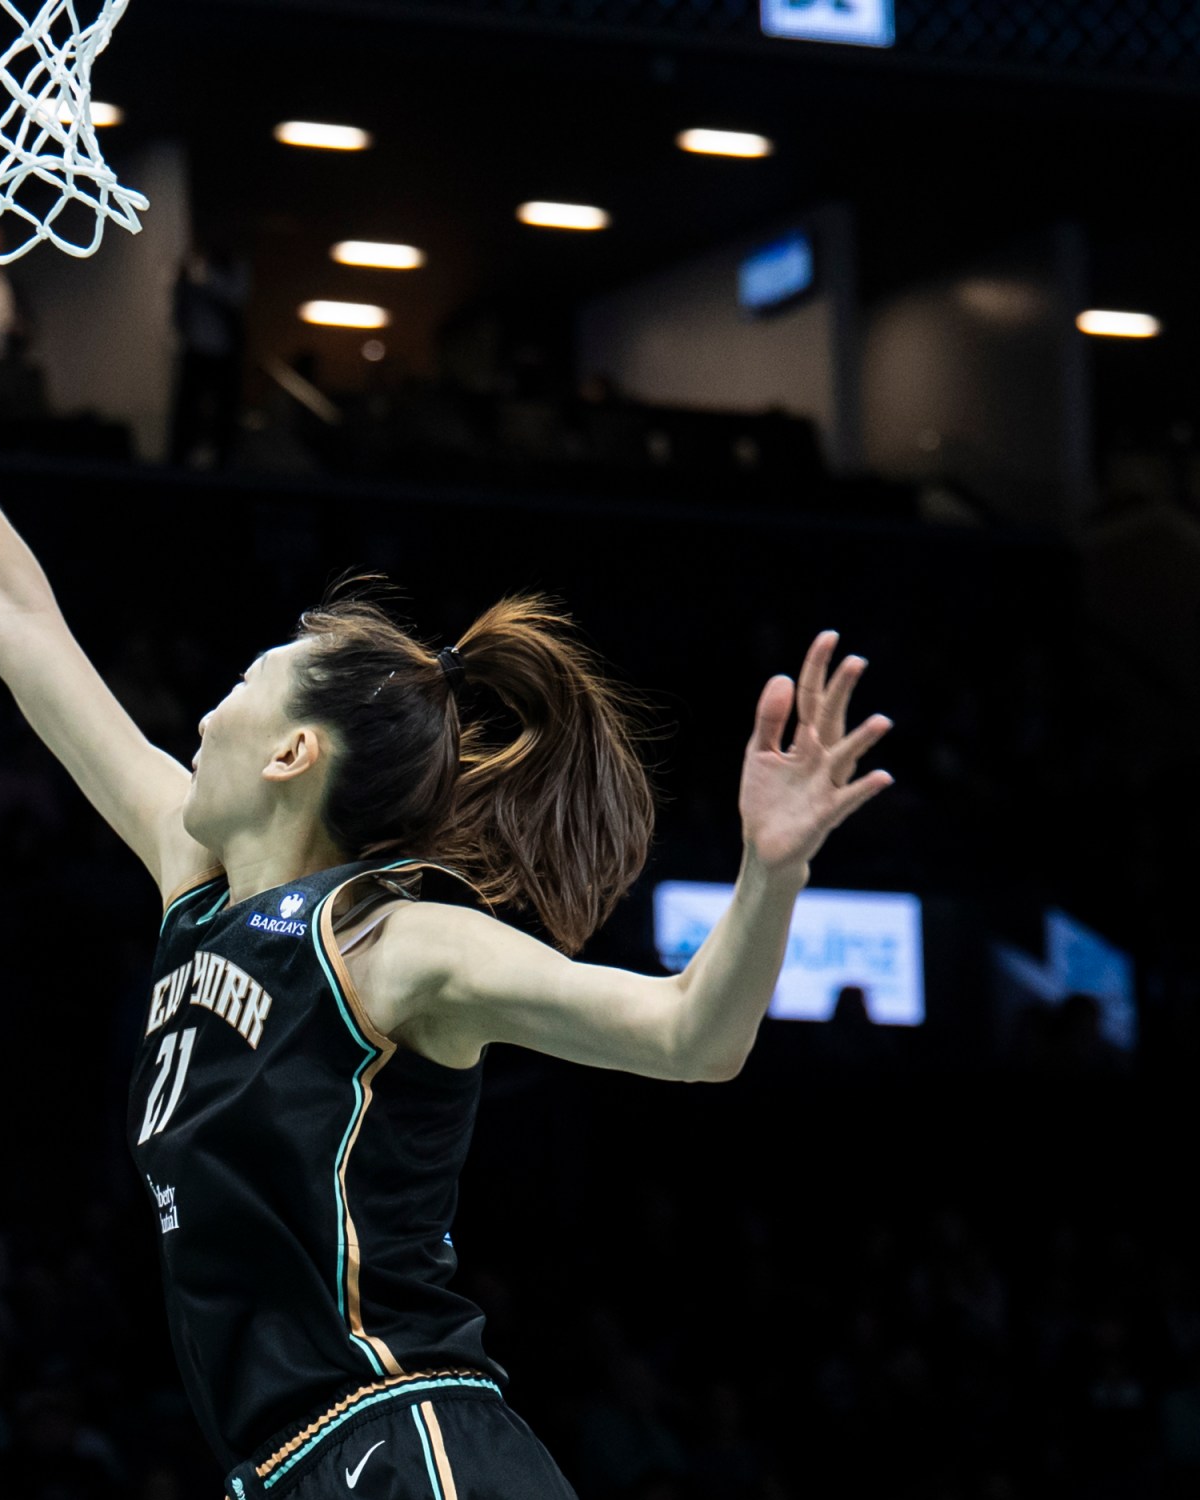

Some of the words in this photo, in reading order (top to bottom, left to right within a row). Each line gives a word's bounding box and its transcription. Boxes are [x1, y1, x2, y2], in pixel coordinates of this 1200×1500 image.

[250, 914, 307, 936] BARCLAYS
[143, 960, 193, 1040] EW
[190, 950, 273, 1050] YORK
[137, 1027, 198, 1146] 21
